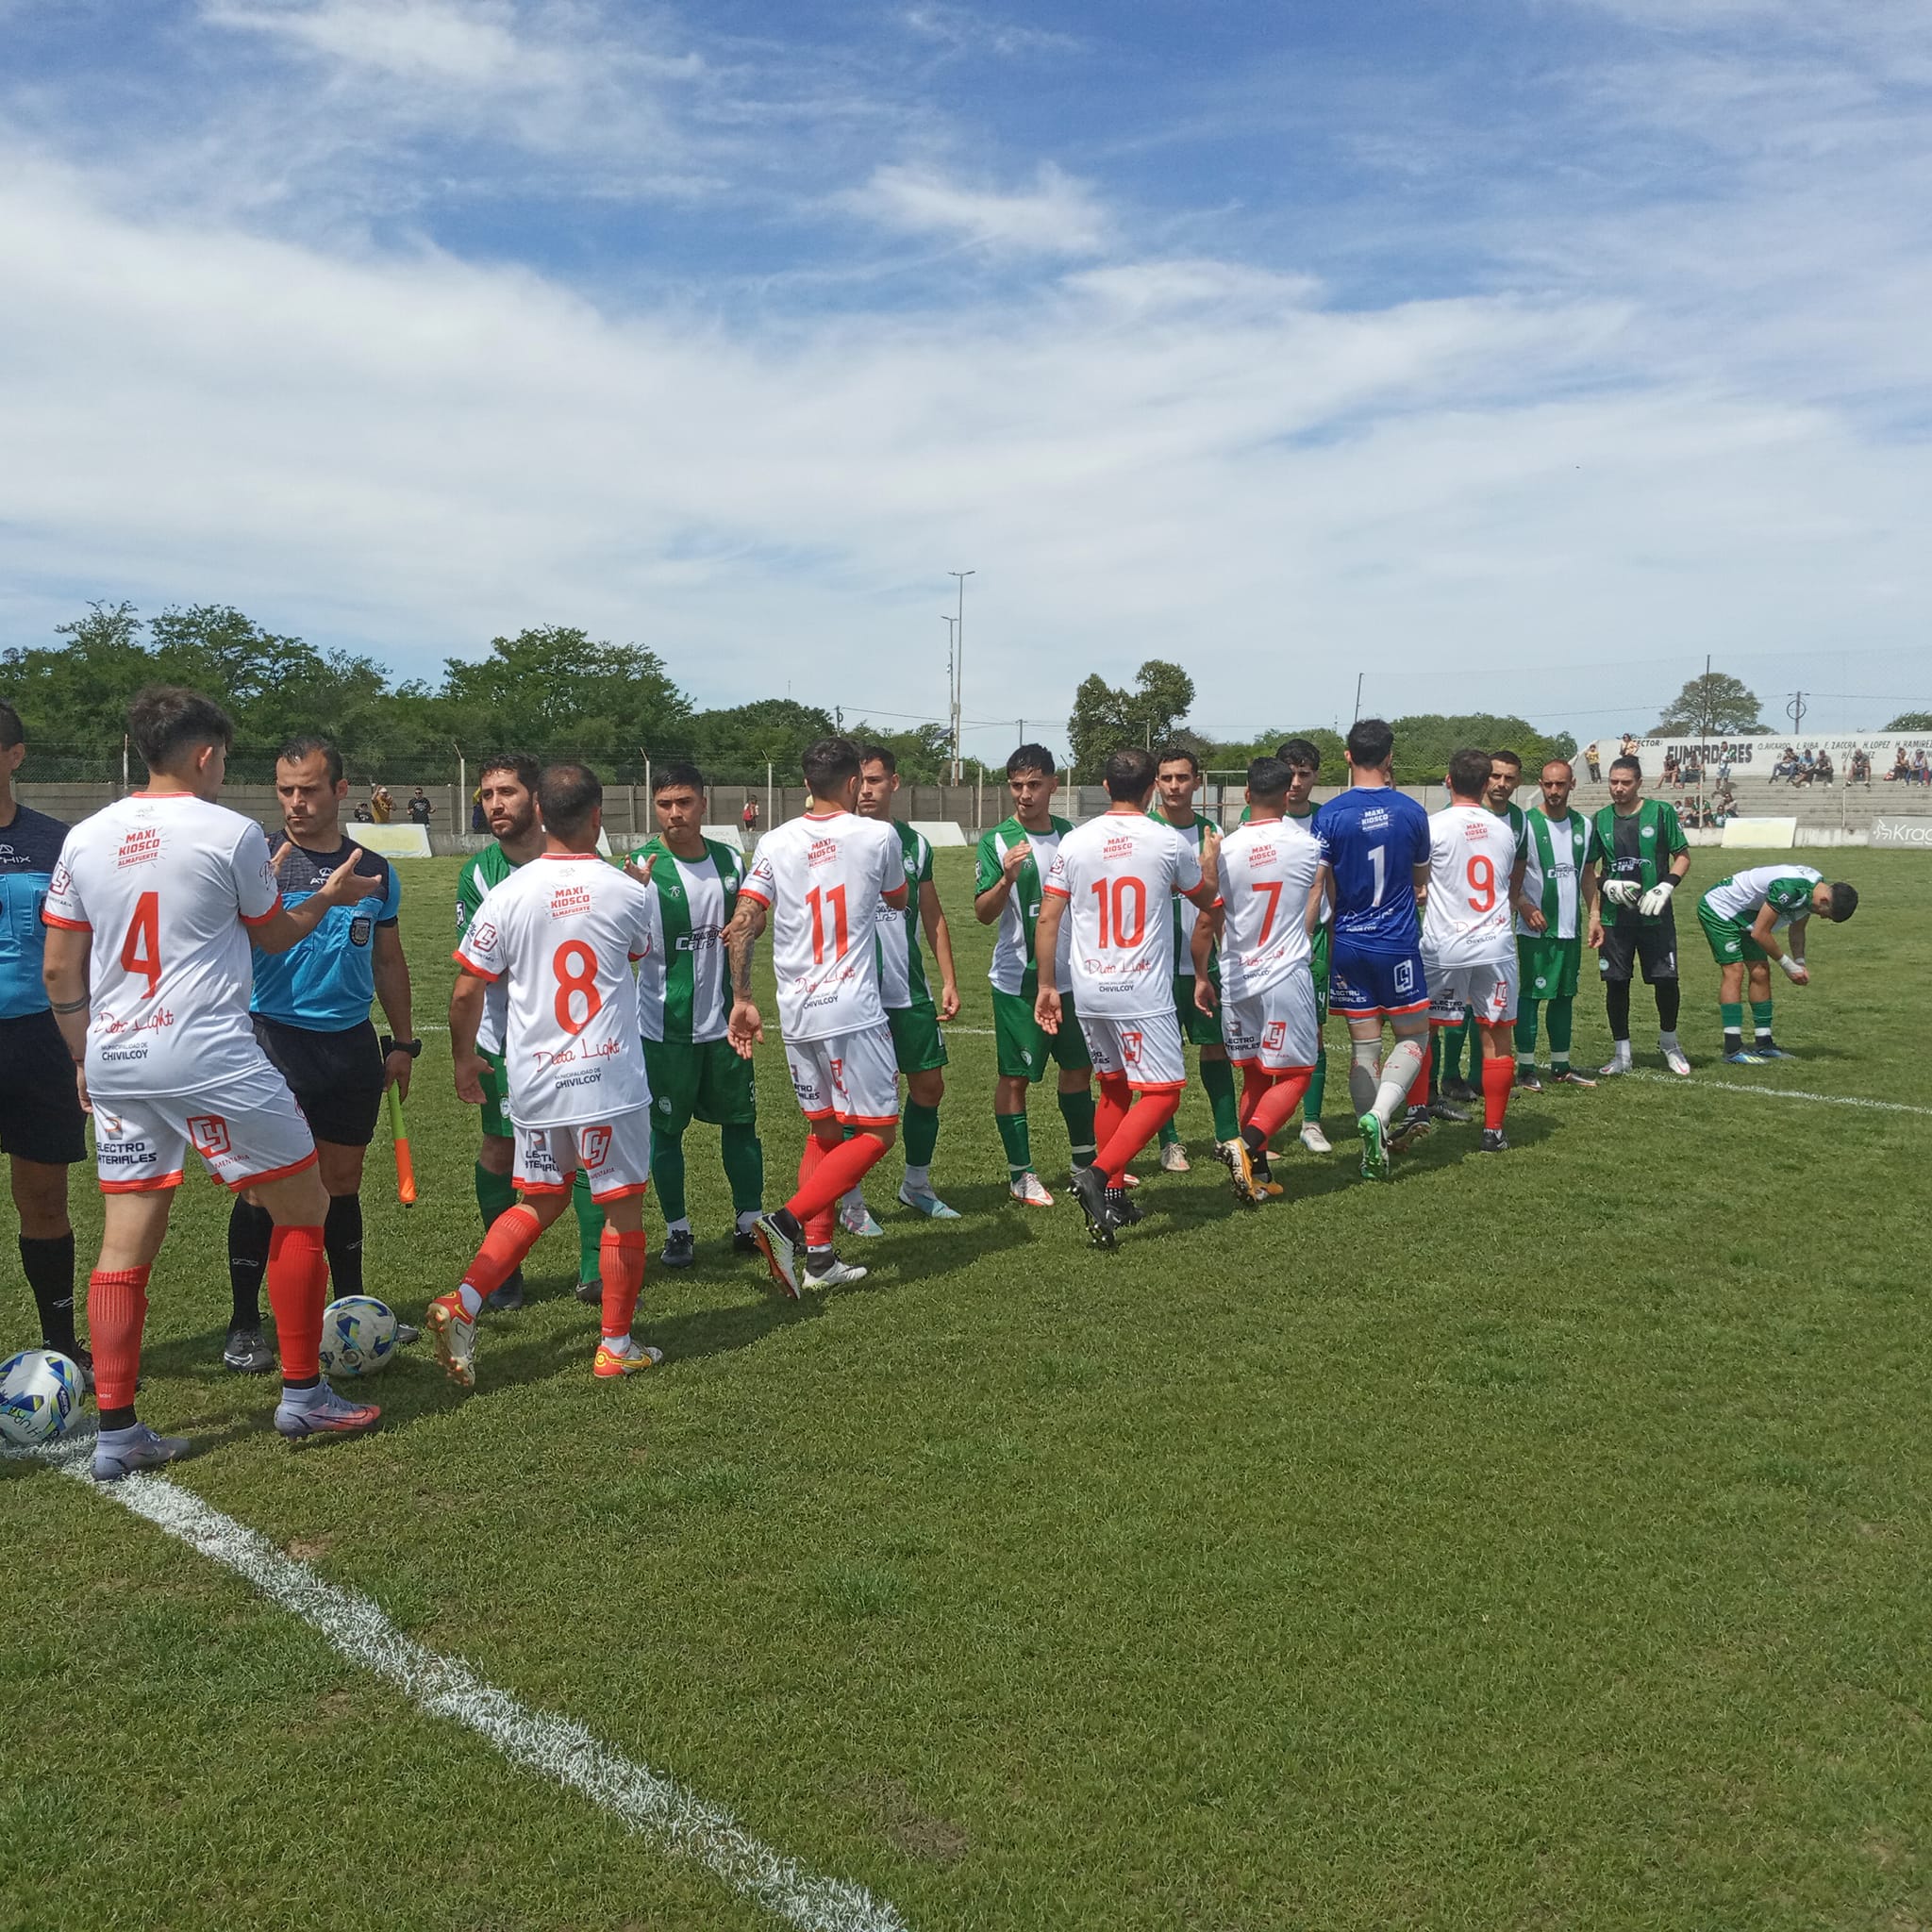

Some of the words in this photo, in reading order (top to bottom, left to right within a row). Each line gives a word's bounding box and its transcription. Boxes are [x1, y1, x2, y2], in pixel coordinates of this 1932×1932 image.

[1361, 814, 1389, 825] KIOSCO
[1364, 808, 1384, 817] MAXI
[125, 828, 156, 843] MAXI
[1108, 836, 1129, 845] MAXI
[118, 839, 160, 857] KIOSCO
[811, 838, 831, 851] MAXI
[1103, 842, 1132, 853] KIOSCO
[1252, 844, 1272, 854] MAXI
[117, 852, 158, 866] ALMAFUERTE
[808, 844, 837, 860] KIOSCO
[1249, 850, 1276, 861] KIOSCO
[1368, 845, 1384, 907] 1
[1467, 855, 1495, 913] 9
[555, 887, 583, 898] MAXI
[551, 894, 590, 908] KIOSCO
[552, 906, 591, 917] ALMAFUERTE
[1091, 876, 1146, 948] 10
[1252, 882, 1283, 947] 7
[806, 883, 849, 964] 11
[121, 891, 161, 999] 4
[553, 940, 603, 1036] 8
[803, 995, 838, 1009] CHIVILCOY
[101, 1049, 149, 1060] CHIVILCOY
[581, 1038, 620, 1061] Light
[555, 1074, 602, 1089] CHIVILCOY
